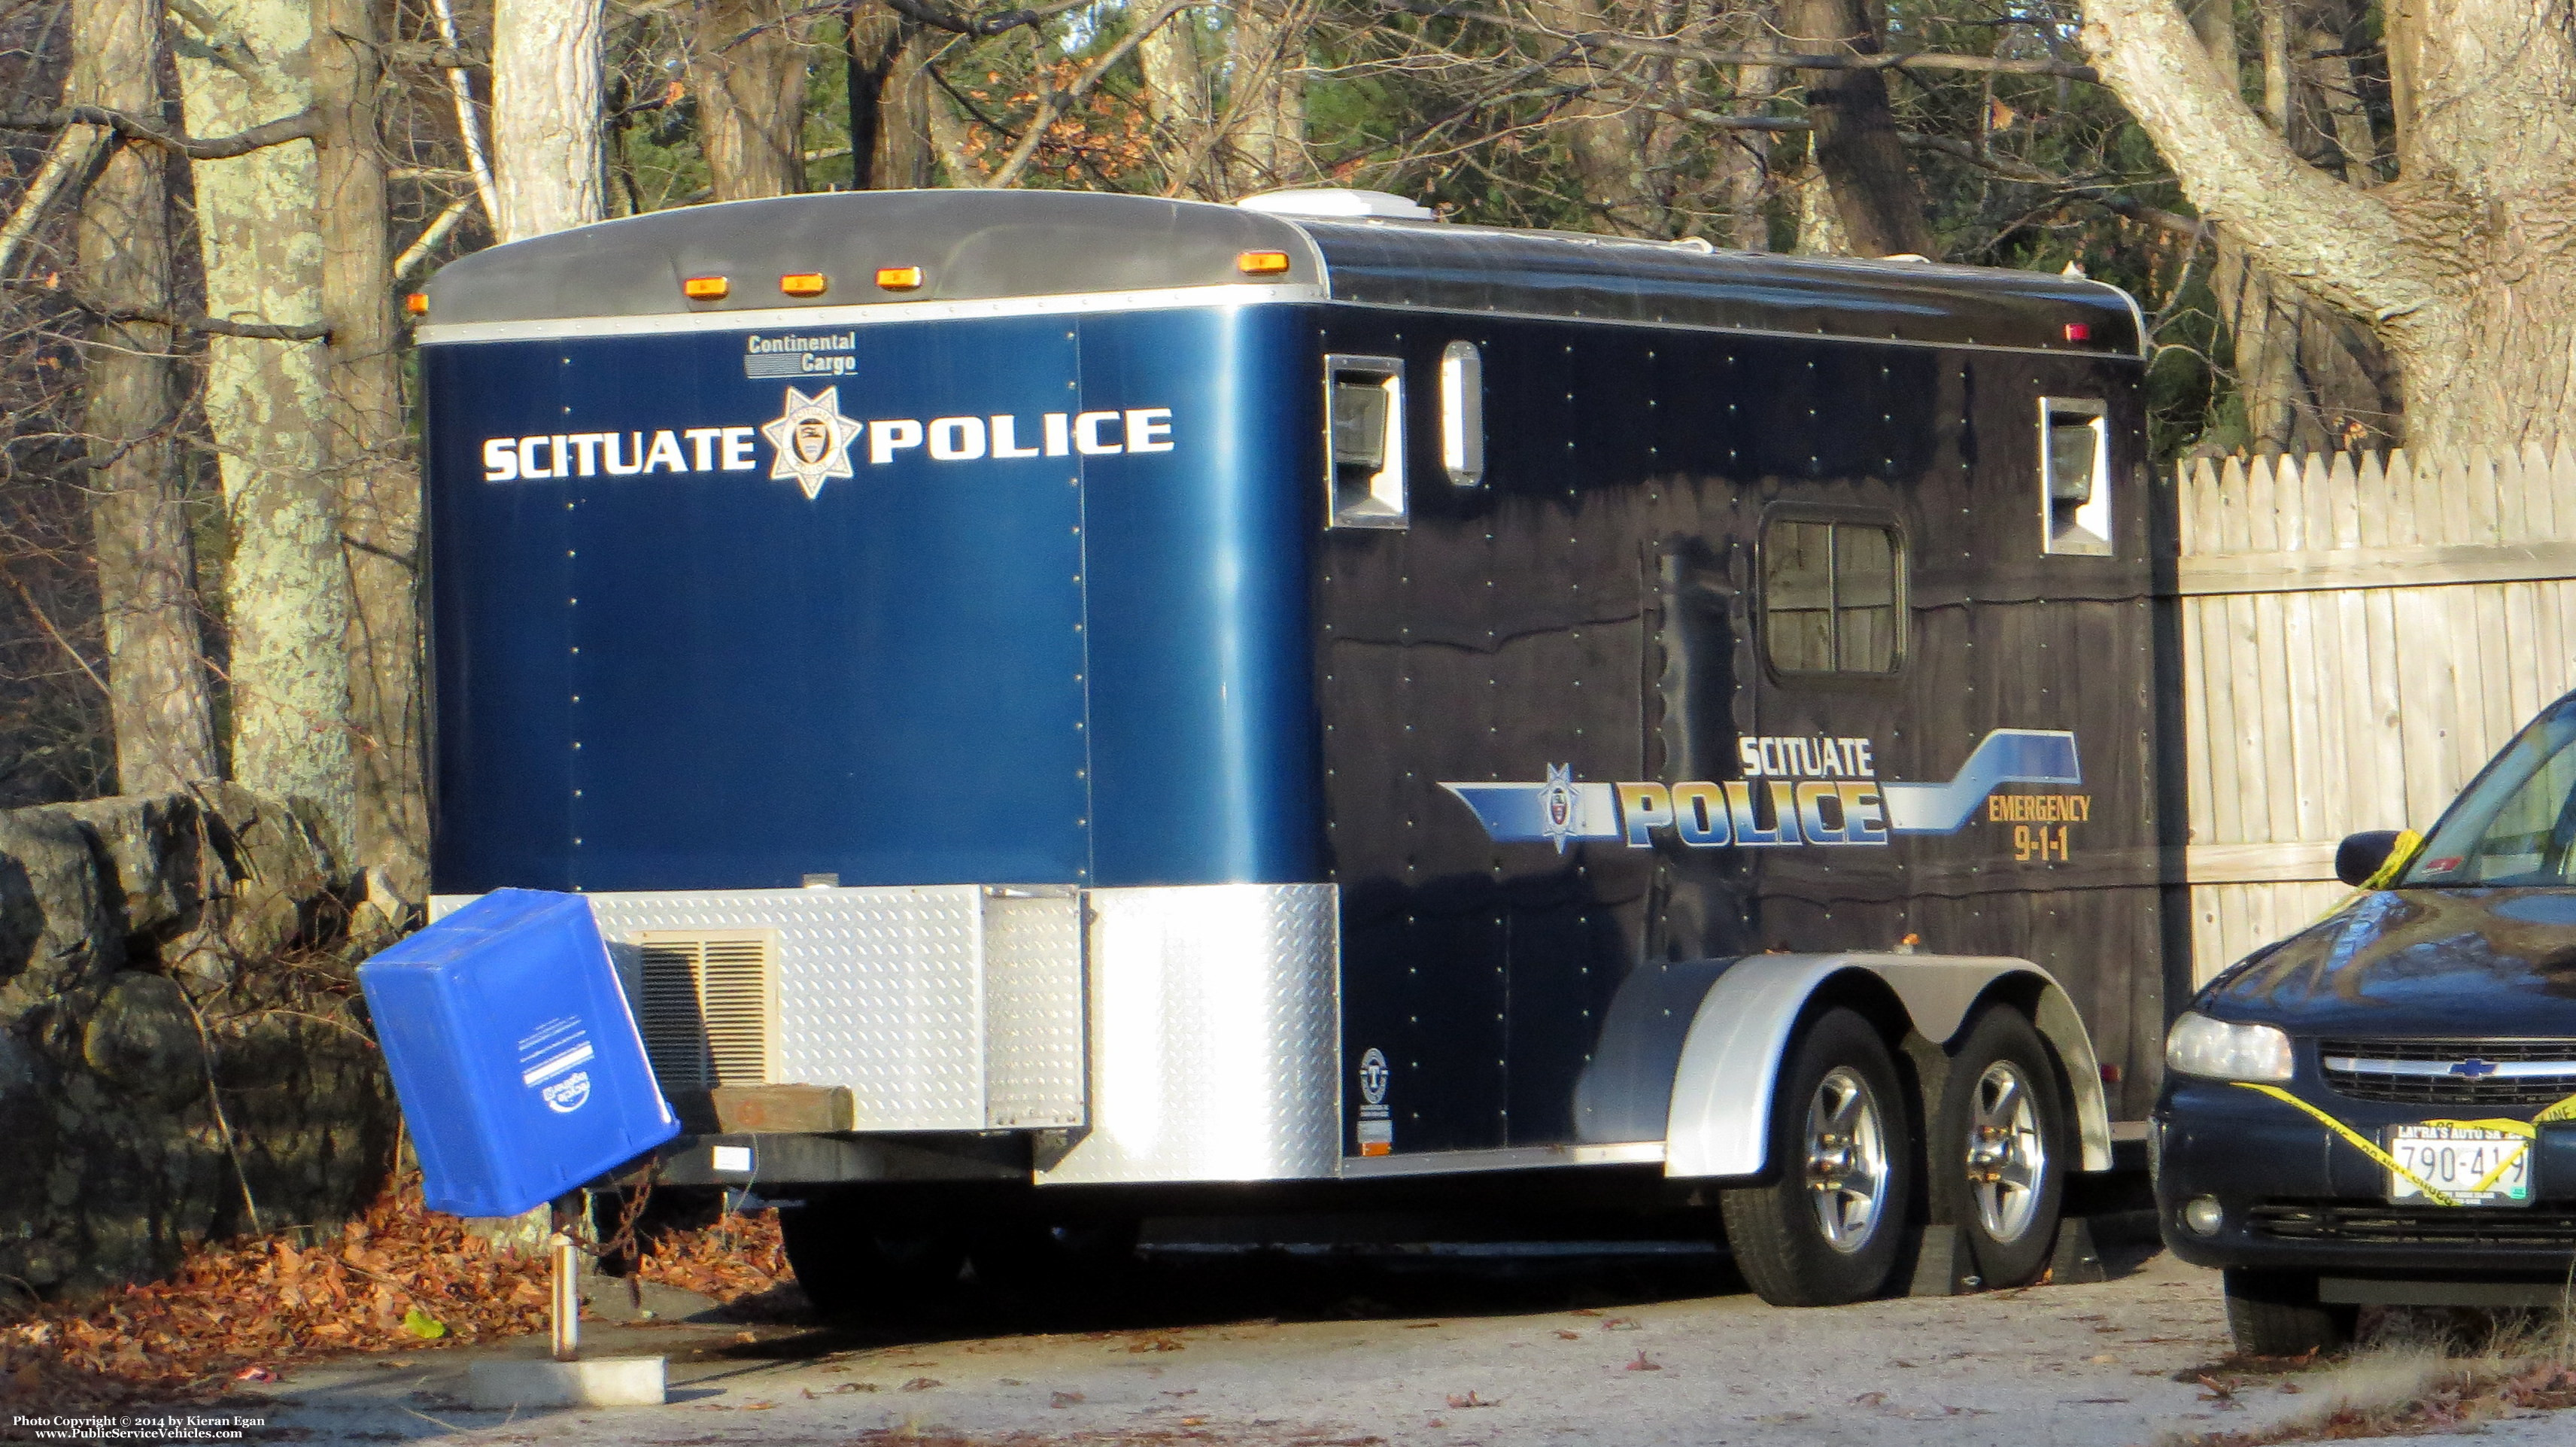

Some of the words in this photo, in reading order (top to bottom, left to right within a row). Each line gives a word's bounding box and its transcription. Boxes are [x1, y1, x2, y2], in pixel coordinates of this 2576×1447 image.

[747, 331, 856, 353] Continental
[802, 352, 856, 375] Cargo
[482, 426, 756, 482] SCITUATE
[868, 408, 1174, 464] POLICE
[1739, 737, 1875, 777] SCITUATE
[1616, 780, 1888, 846] POLICE
[1988, 795, 2091, 822] EMERGENCY
[2014, 825, 2068, 861] 9-1-1
